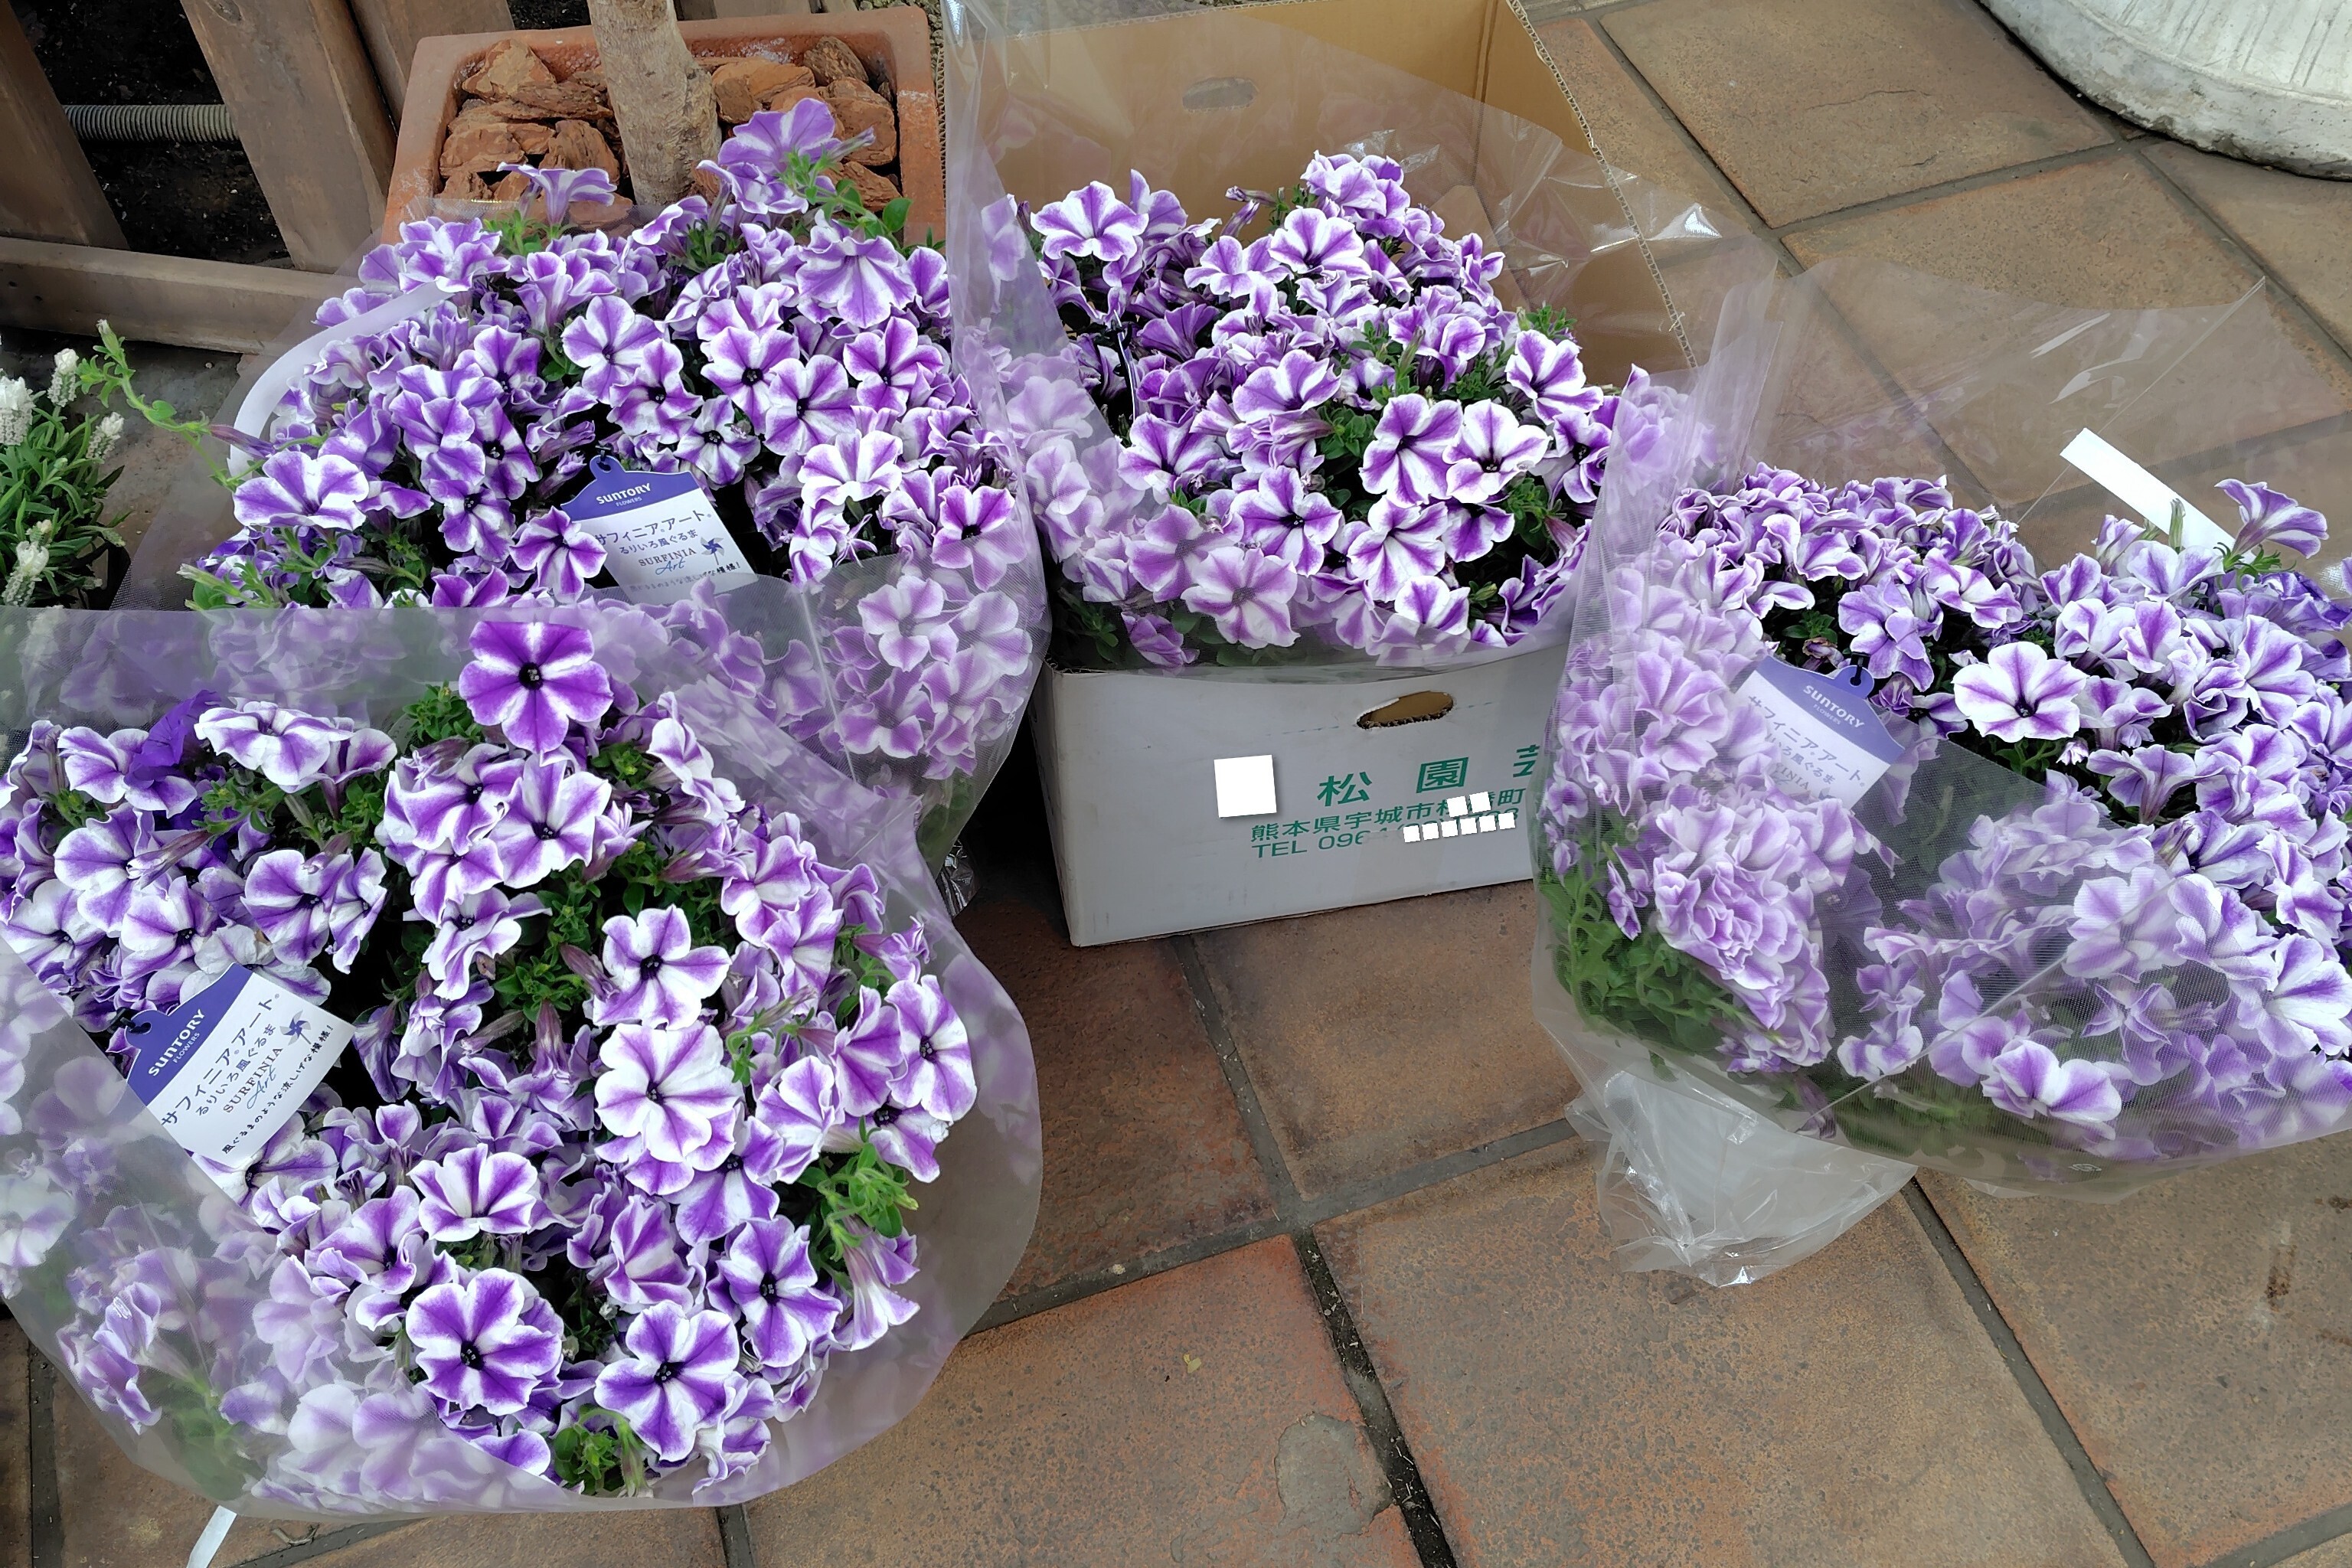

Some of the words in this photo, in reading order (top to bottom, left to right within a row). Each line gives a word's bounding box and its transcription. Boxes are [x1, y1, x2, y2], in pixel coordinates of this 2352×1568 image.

[616, 496, 642, 507] FLOWERS
[619, 529, 698, 554] るりいろ風ぐるま
[638, 547, 697, 567] SURFINIA
[655, 558, 687, 575] Art
[1813, 704, 1841, 725] FLOWERS
[1250, 788, 1526, 843] 熊本県宇城市町
[1251, 840, 1308, 858] TEL
[172, 1032, 200, 1063] FLOWERS
[196, 1024, 276, 1116] るりいろ風ぐるま
[223, 1047, 283, 1113] SURFINIA
[247, 1066, 276, 1109] Art
